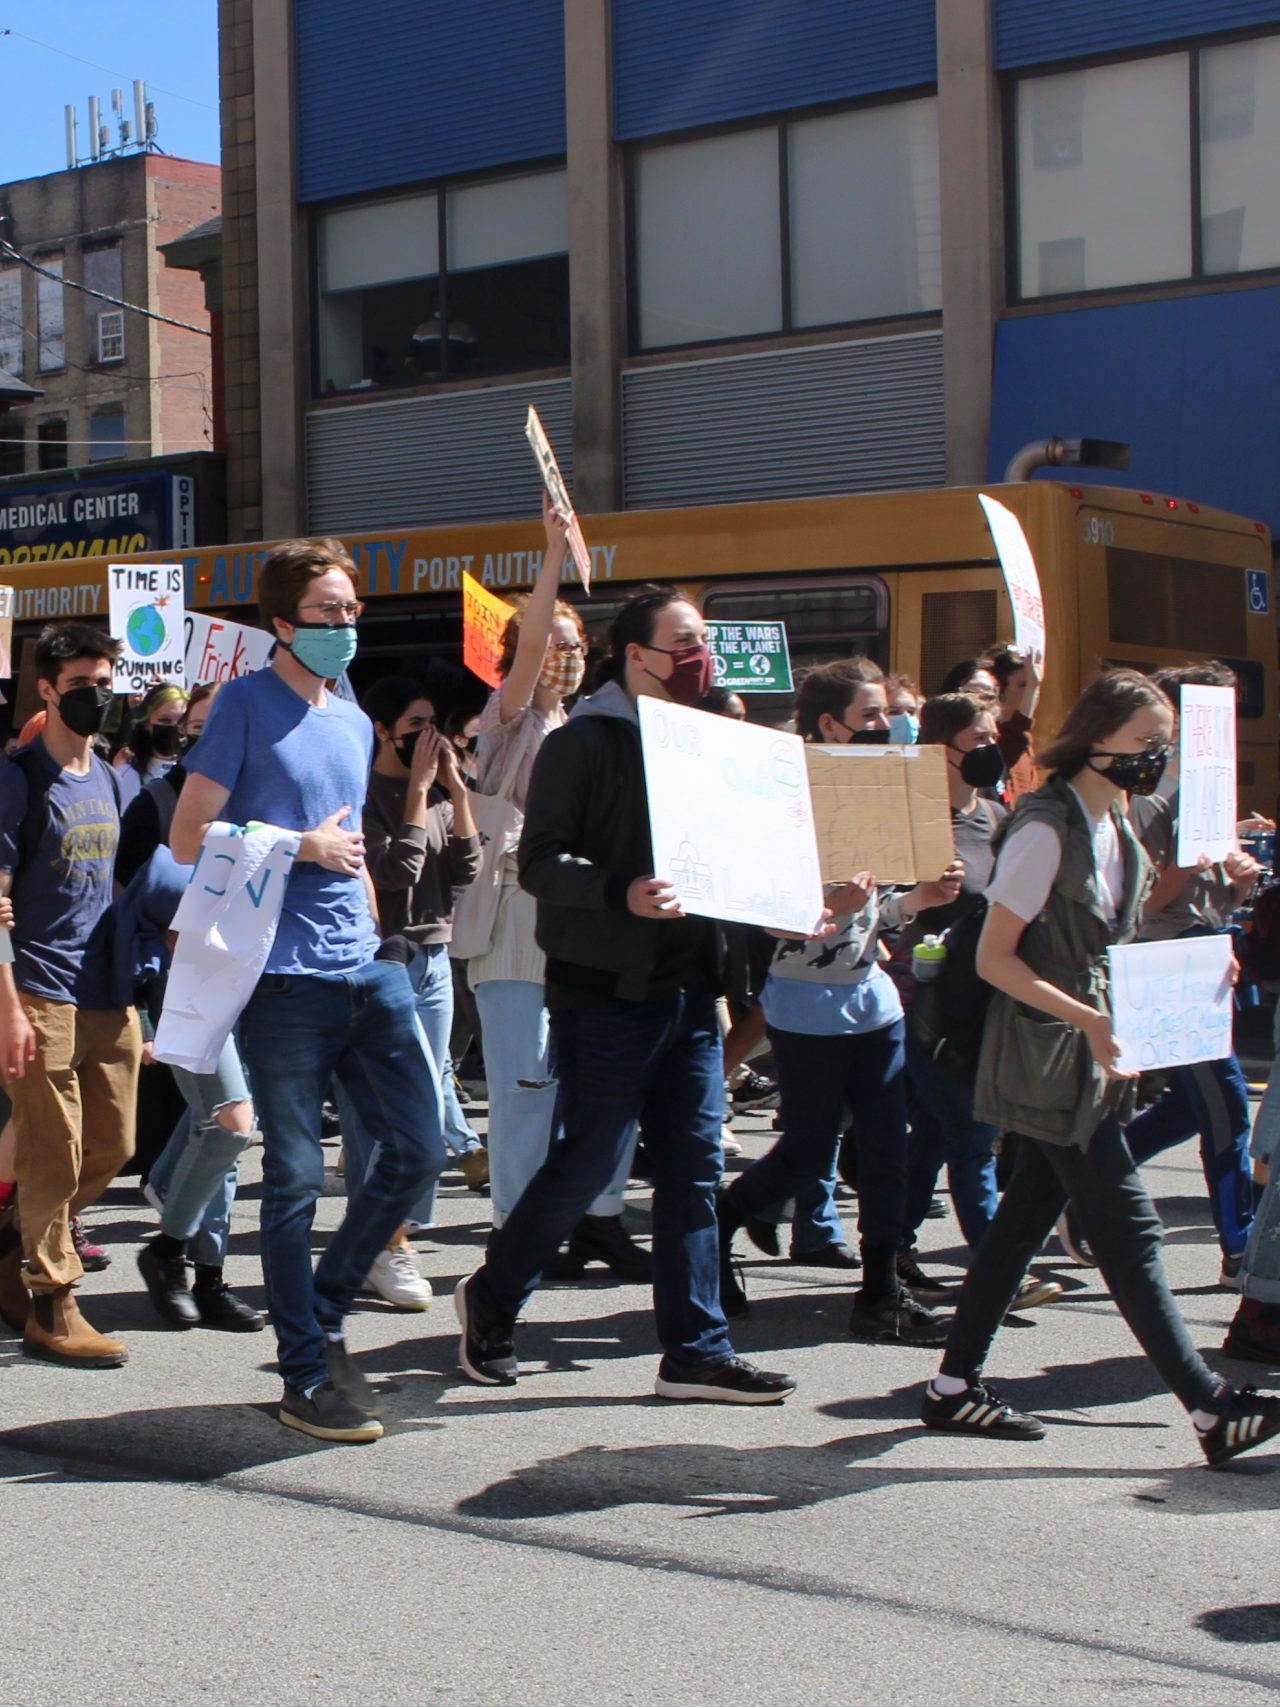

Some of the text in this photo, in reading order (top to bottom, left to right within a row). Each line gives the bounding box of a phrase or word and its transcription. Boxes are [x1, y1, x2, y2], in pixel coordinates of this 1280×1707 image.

[73, 492, 140, 522] CENTER
[179, 479, 190, 549] OPTI
[481, 544, 617, 587] AUTHRTY
[112, 568, 160, 592] TIME
[167, 568, 181, 593] IS
[12, 584, 102, 619] UTHORITY
[704, 626, 780, 641] OP THE WARS
[719, 641, 739, 654] THE
[741, 641, 781, 654] PLANET
[115, 658, 184, 678] RUNNING
